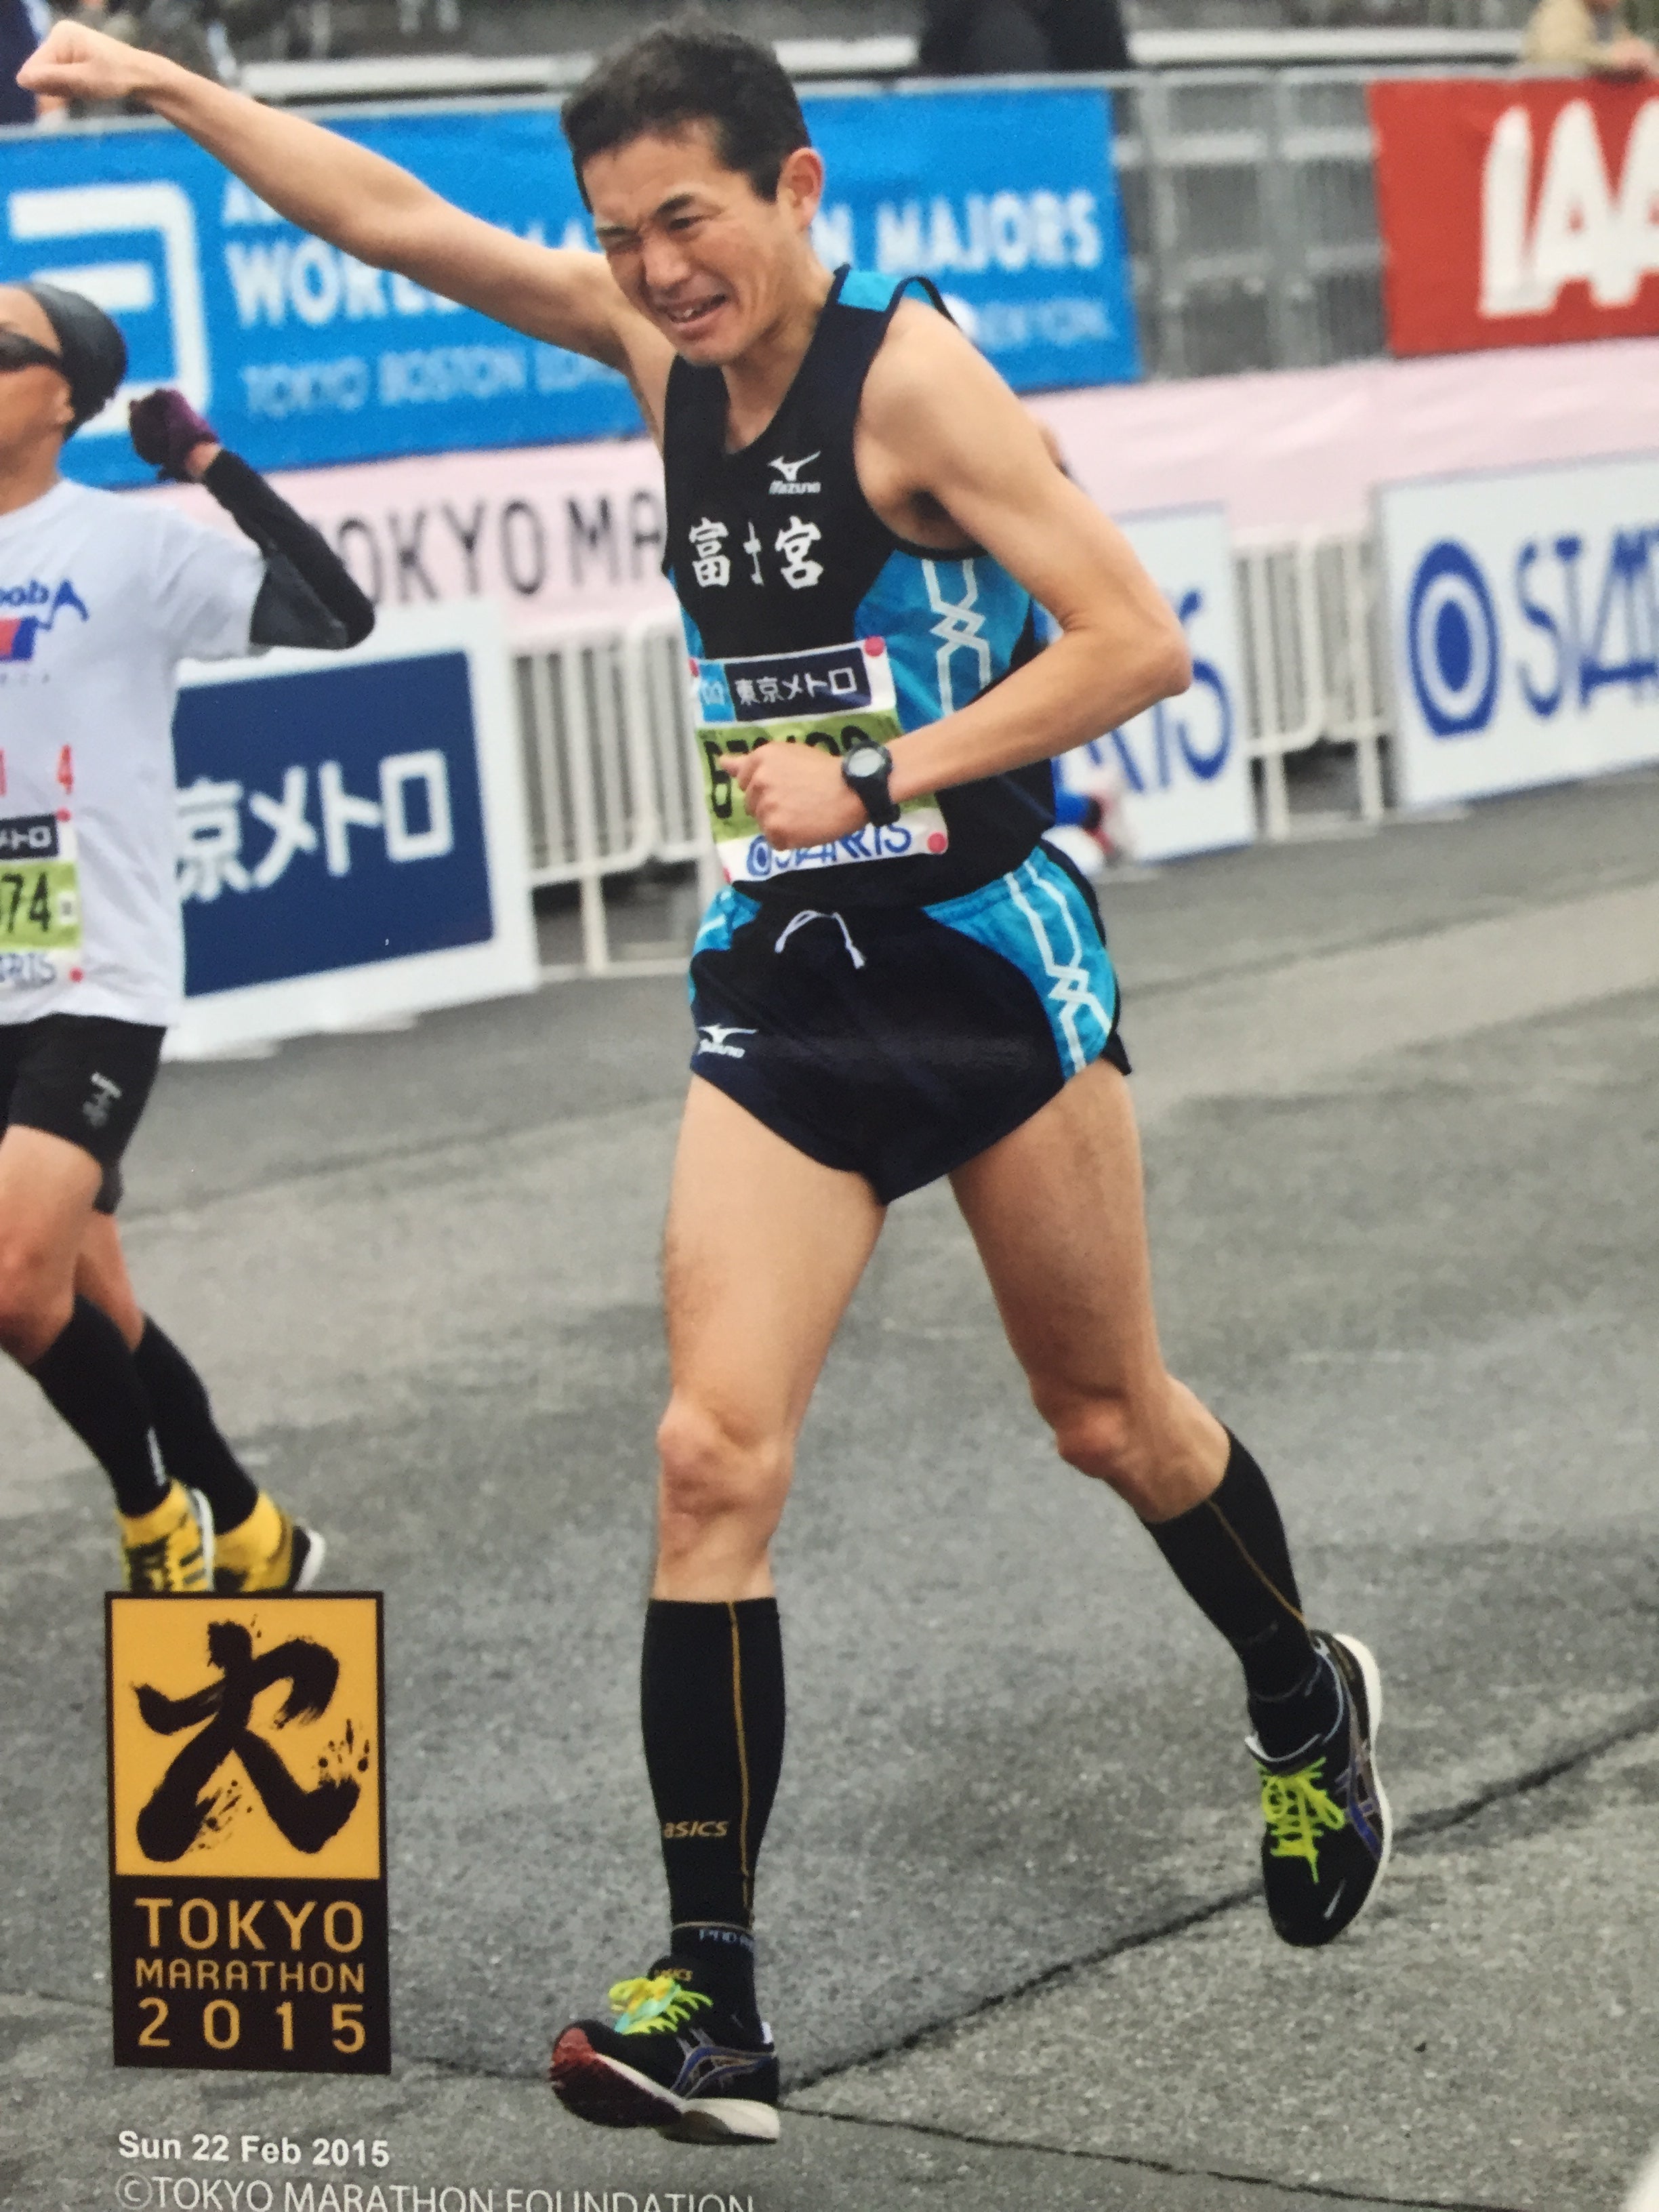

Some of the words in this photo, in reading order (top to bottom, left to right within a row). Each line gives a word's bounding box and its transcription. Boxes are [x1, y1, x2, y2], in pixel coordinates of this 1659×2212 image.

[877, 188, 1102, 270] MAJORS
[337, 498, 546, 605] OKYO
[735, 667, 859, 706] 東京メトロ
[177, 750, 454, 902] 京メトロ
